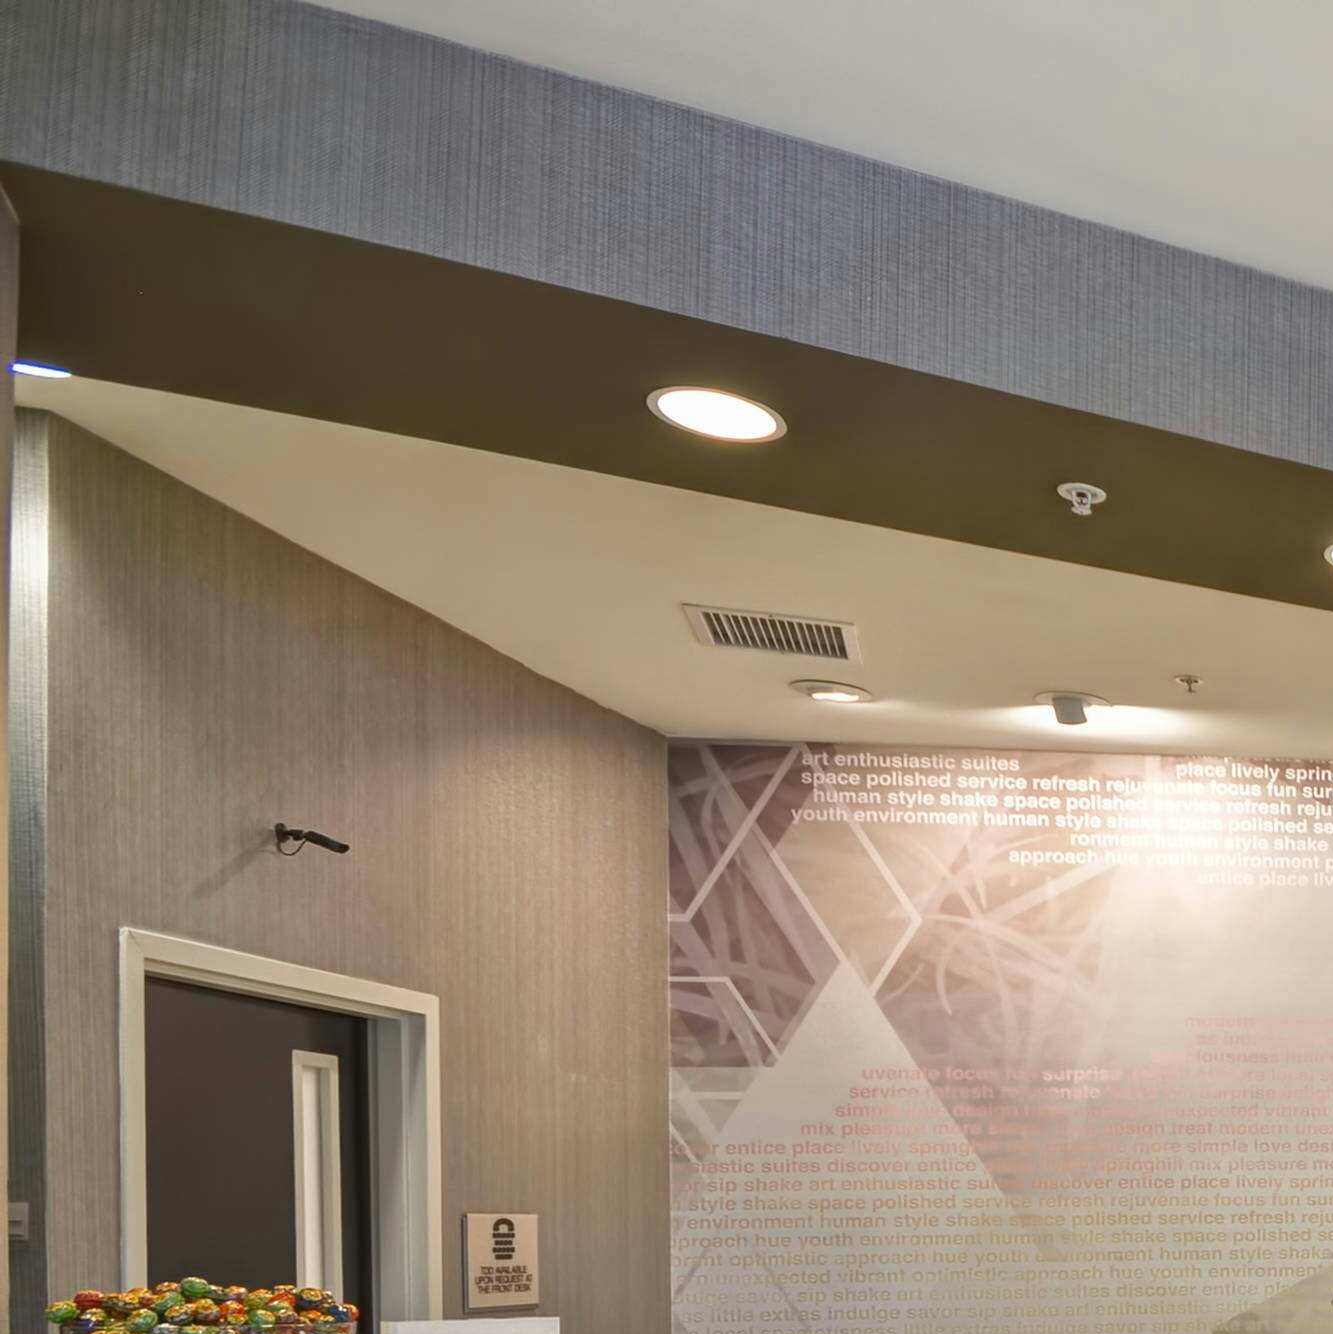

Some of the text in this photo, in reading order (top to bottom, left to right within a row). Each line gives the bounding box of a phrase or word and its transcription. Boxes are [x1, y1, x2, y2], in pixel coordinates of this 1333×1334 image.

[802, 751, 1019, 772] art enthusiastic suites
[1176, 761, 1226, 782] place
[1232, 763, 1279, 784] lively
[801, 771, 860, 788] space
[867, 769, 951, 791] polished
[957, 773, 1027, 789] service
[1032, 774, 1100, 791] refresh
[1106, 777, 1203, 798] rejuvenate
[1210, 779, 1261, 796] focus
[1267, 781, 1296, 797] fun
[813, 787, 881, 804] human
[888, 789, 934, 809] style
[940, 790, 998, 807] shake
[1004, 796, 1060, 813] space
[1066, 794, 1146, 815] polished
[1227, 798, 1291, 815] refresh
[791, 805, 848, 826] youth
[854, 808, 979, 825] environment
[984, 810, 1049, 827] human
[1055, 812, 1100, 832] style
[1228, 817, 1307, 838] polished
[1274, 835, 1328, 851] shake
[1009, 846, 1098, 867] approach
[1204, 852, 1319, 869] environment
[761, 1157, 976, 1173] suites discover entice
[707, 1177, 737, 1196] sip
[744, 1176, 802, 1191] shake
[809, 1177, 834, 1191] art
[841, 1175, 961, 1191] enthusiastic
[1118, 1175, 1174, 1189] entice
[1180, 1173, 1229, 1193] place
[1236, 1173, 1282, 1192] lively
[688, 1208, 1295, 1231] environment human style shake polished service refresh
